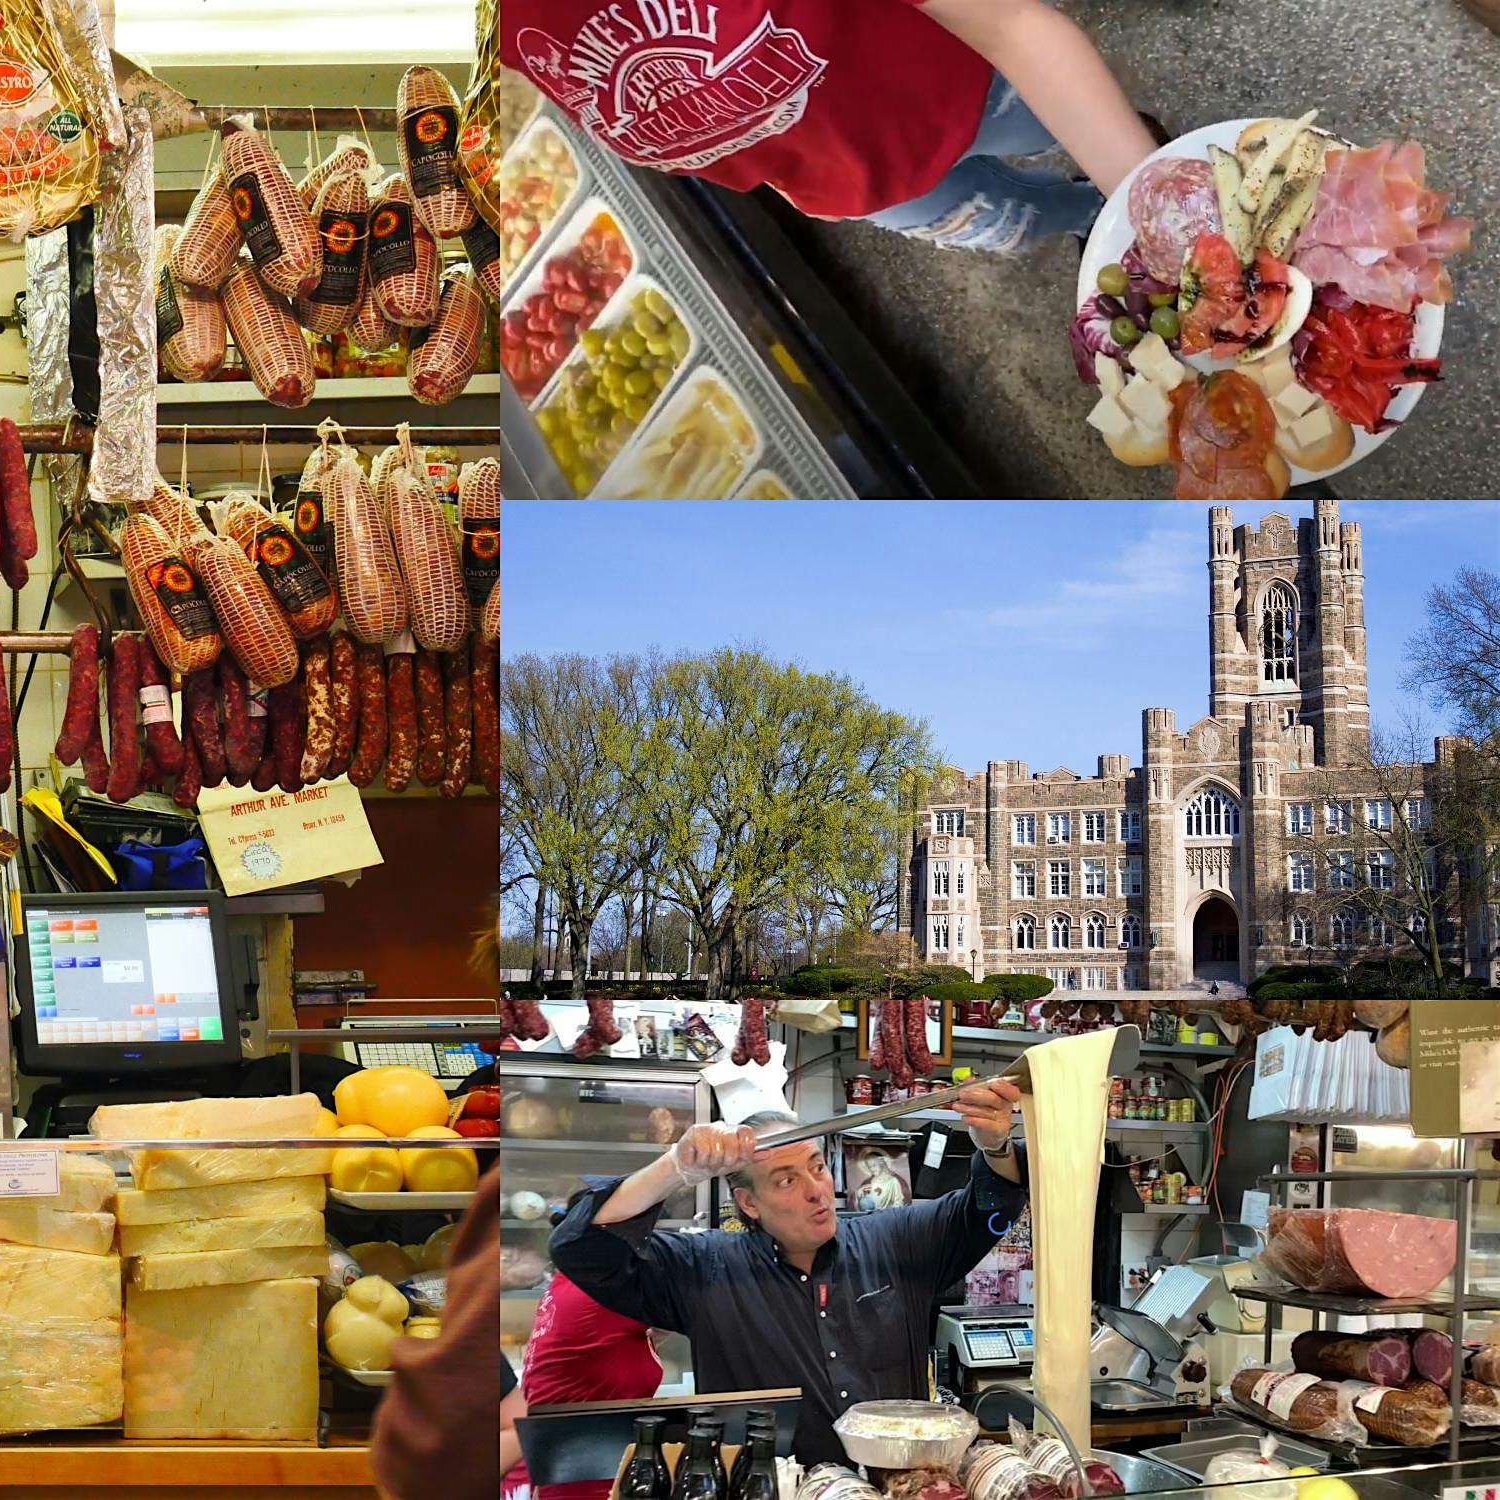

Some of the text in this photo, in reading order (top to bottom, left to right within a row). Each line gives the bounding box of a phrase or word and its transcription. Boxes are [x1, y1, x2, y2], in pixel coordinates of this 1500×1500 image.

[569, 2, 645, 88] MIKE'S
[637, 0, 718, 44] DELI
[626, 59, 697, 110] ARTHUR
[49, 123, 83, 132] NATURAL
[59, 117, 71, 125] ALL
[637, 88, 748, 145] ITALIAN
[230, 786, 329, 817] ARTHUR AVE. MARKET
